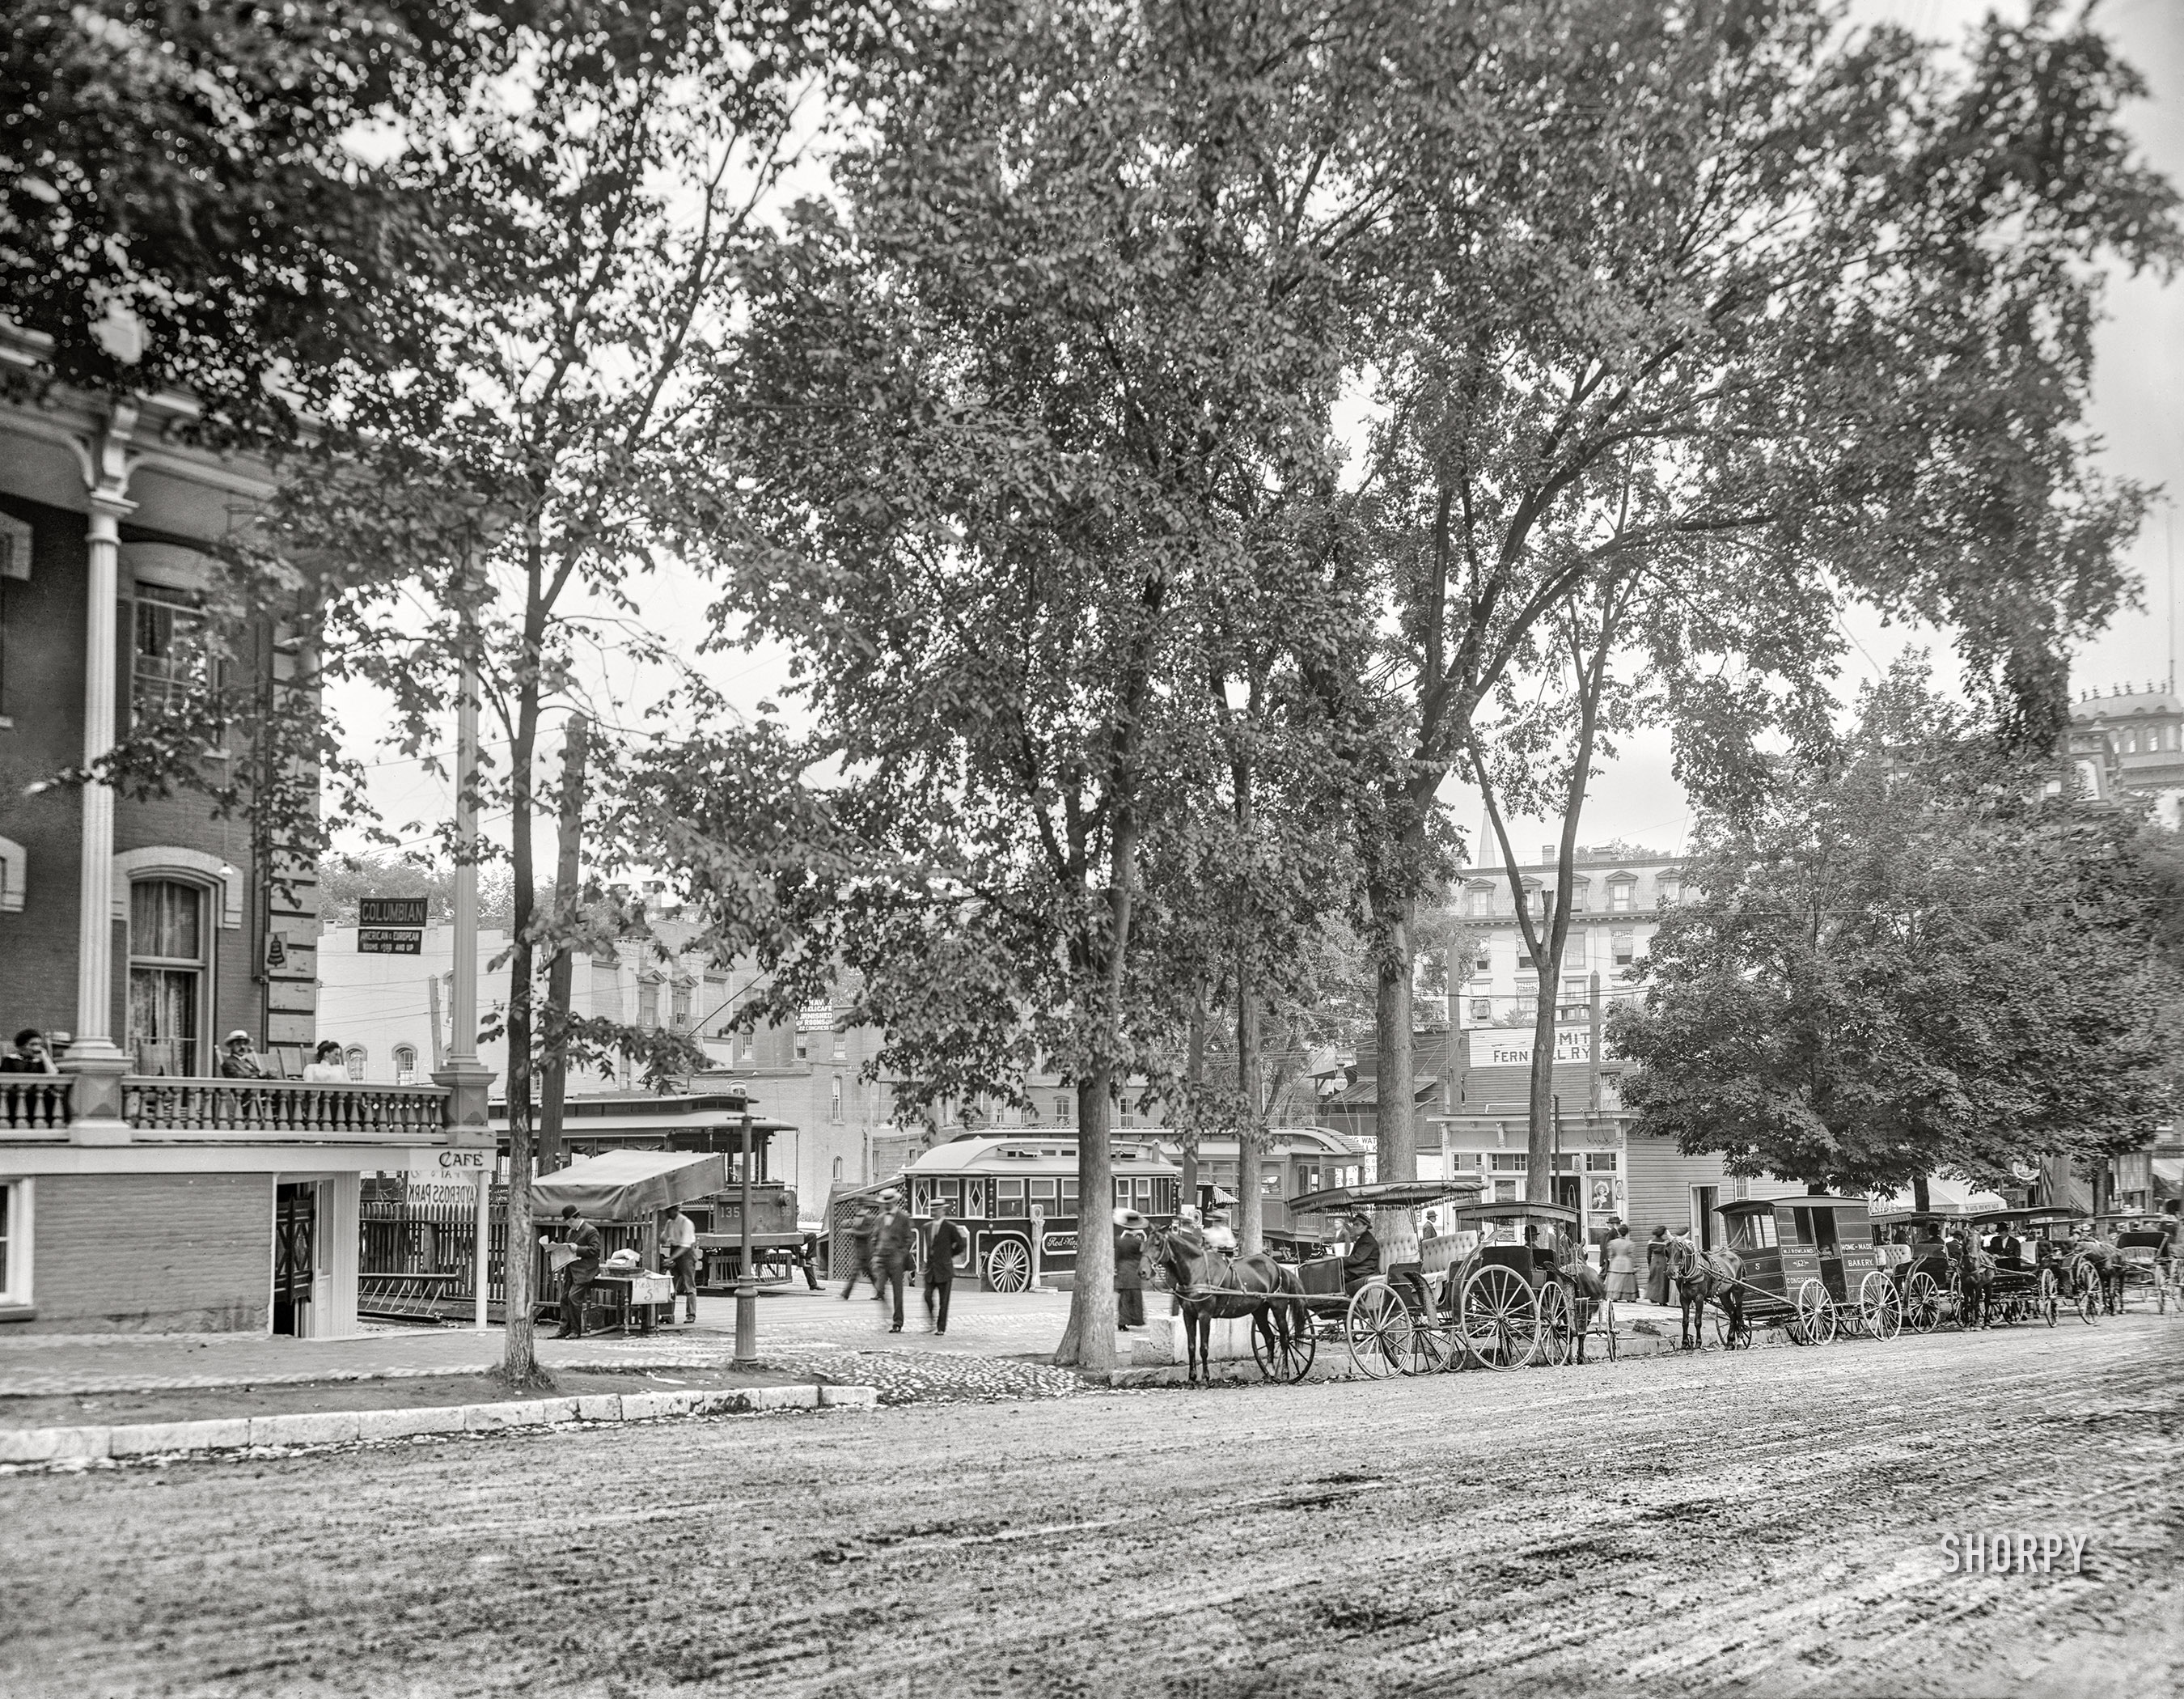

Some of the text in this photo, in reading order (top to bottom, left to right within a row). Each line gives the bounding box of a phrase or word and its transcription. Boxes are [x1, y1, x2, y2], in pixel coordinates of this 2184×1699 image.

[362, 902, 424, 922] COLUMBIAN
[360, 931, 388, 941] AMERICAN
[393, 931, 420, 941] EUROPEAN
[1559, 1032, 1591, 1045] MIT
[1493, 1050, 1528, 1062] FERN
[438, 1150, 484, 1167] CAFÉ
[721, 1206, 740, 1218] 135
[1841, 1243, 1873, 1251] HOME-MADE
[1848, 1259, 1874, 1267] BAKERY.
